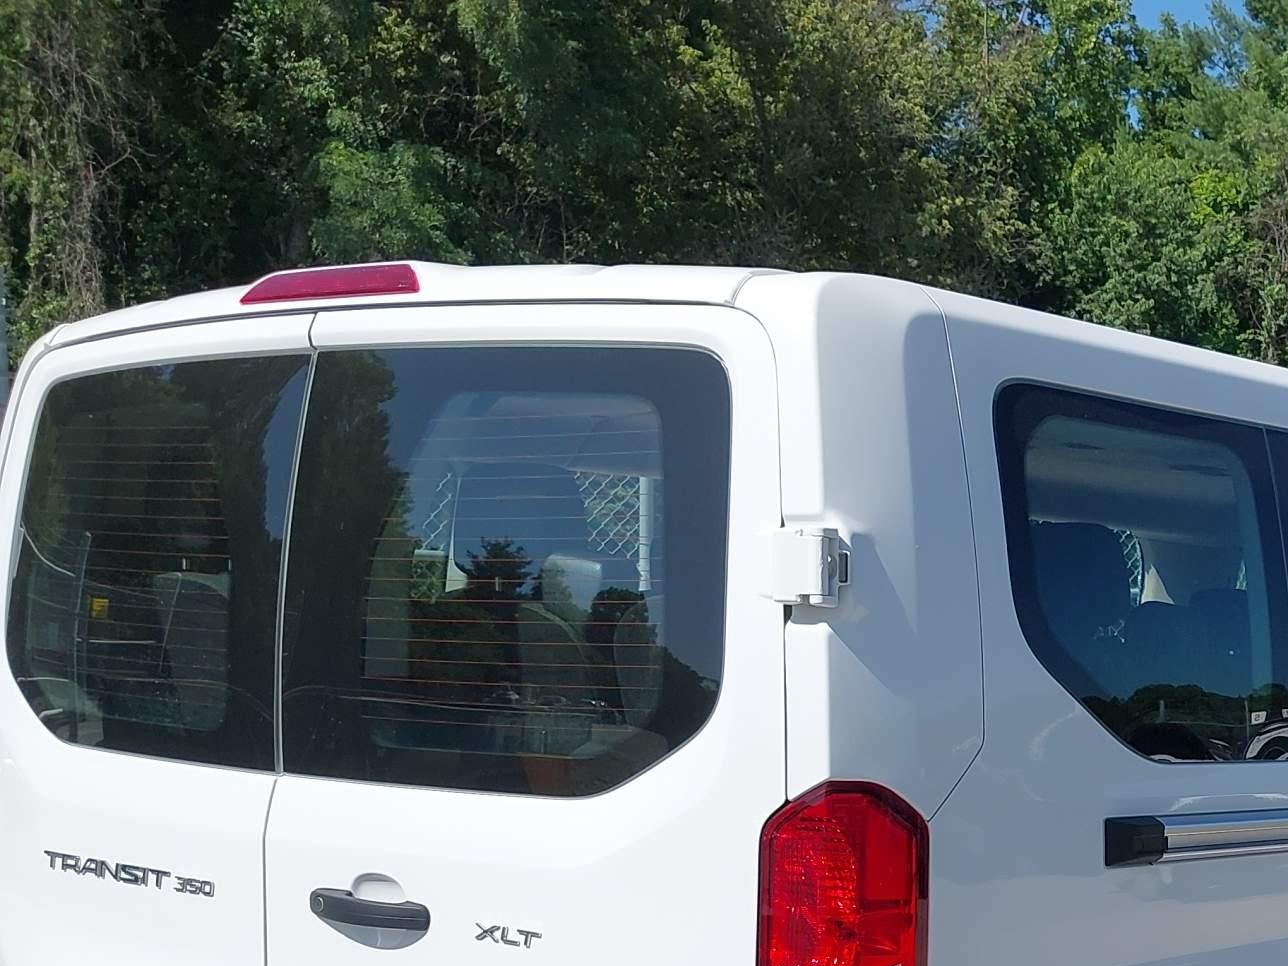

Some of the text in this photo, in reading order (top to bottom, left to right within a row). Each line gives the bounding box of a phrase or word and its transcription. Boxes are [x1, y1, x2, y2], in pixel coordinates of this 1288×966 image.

[44, 850, 215, 898] TRANSIT 350
[475, 922, 543, 949] XLT
